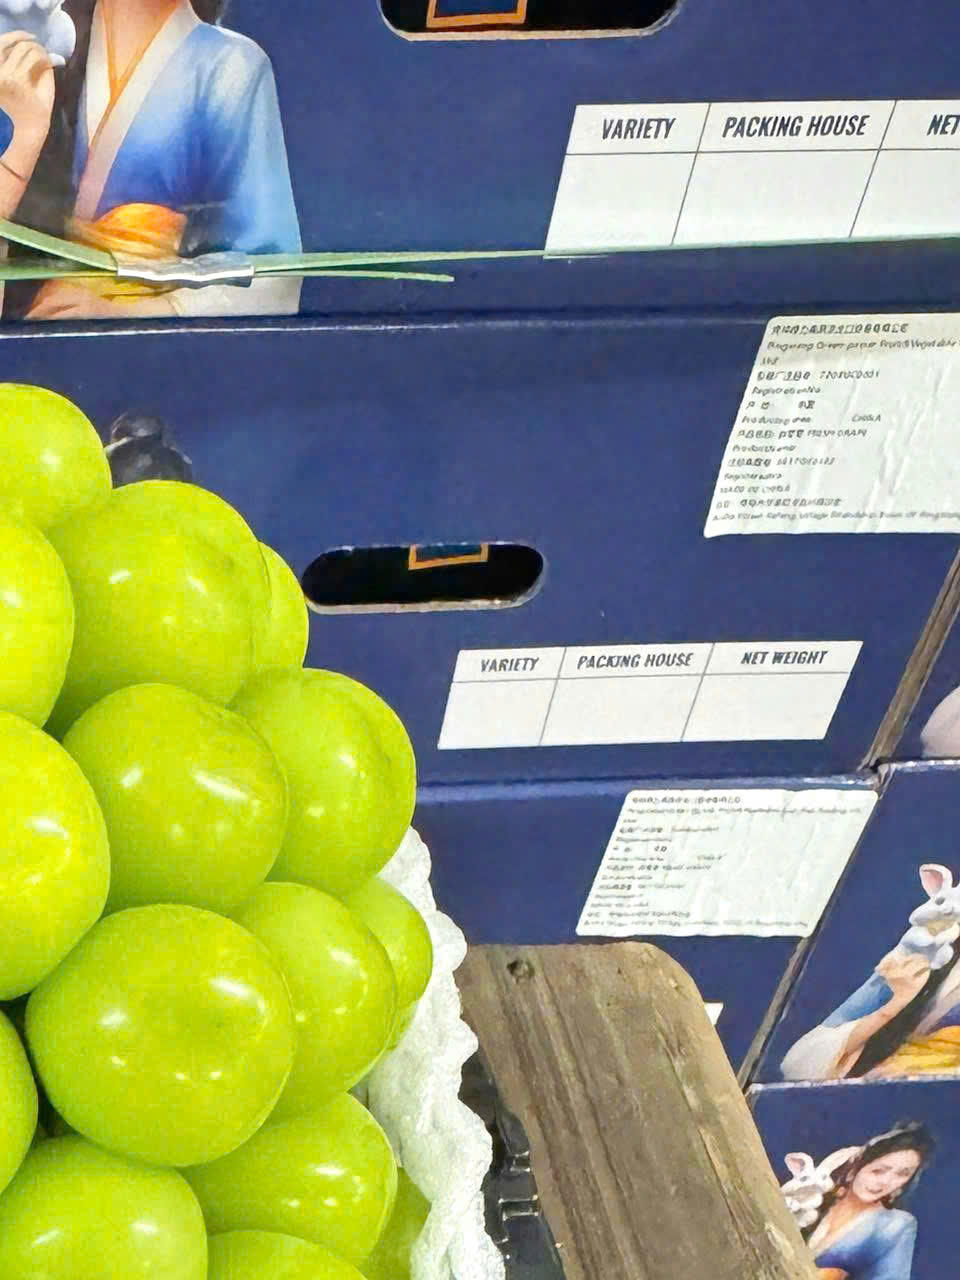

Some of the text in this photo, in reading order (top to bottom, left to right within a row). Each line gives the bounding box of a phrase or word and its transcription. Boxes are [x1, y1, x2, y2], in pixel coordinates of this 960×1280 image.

[602, 117, 676, 140] VARIETY
[722, 114, 871, 138] PACKING HOUSE
[927, 113, 960, 136] NET
[480, 656, 540, 673] VARIETY
[577, 652, 693, 670] PACKING HOUSE
[741, 650, 828, 665] NET WEIGHT
